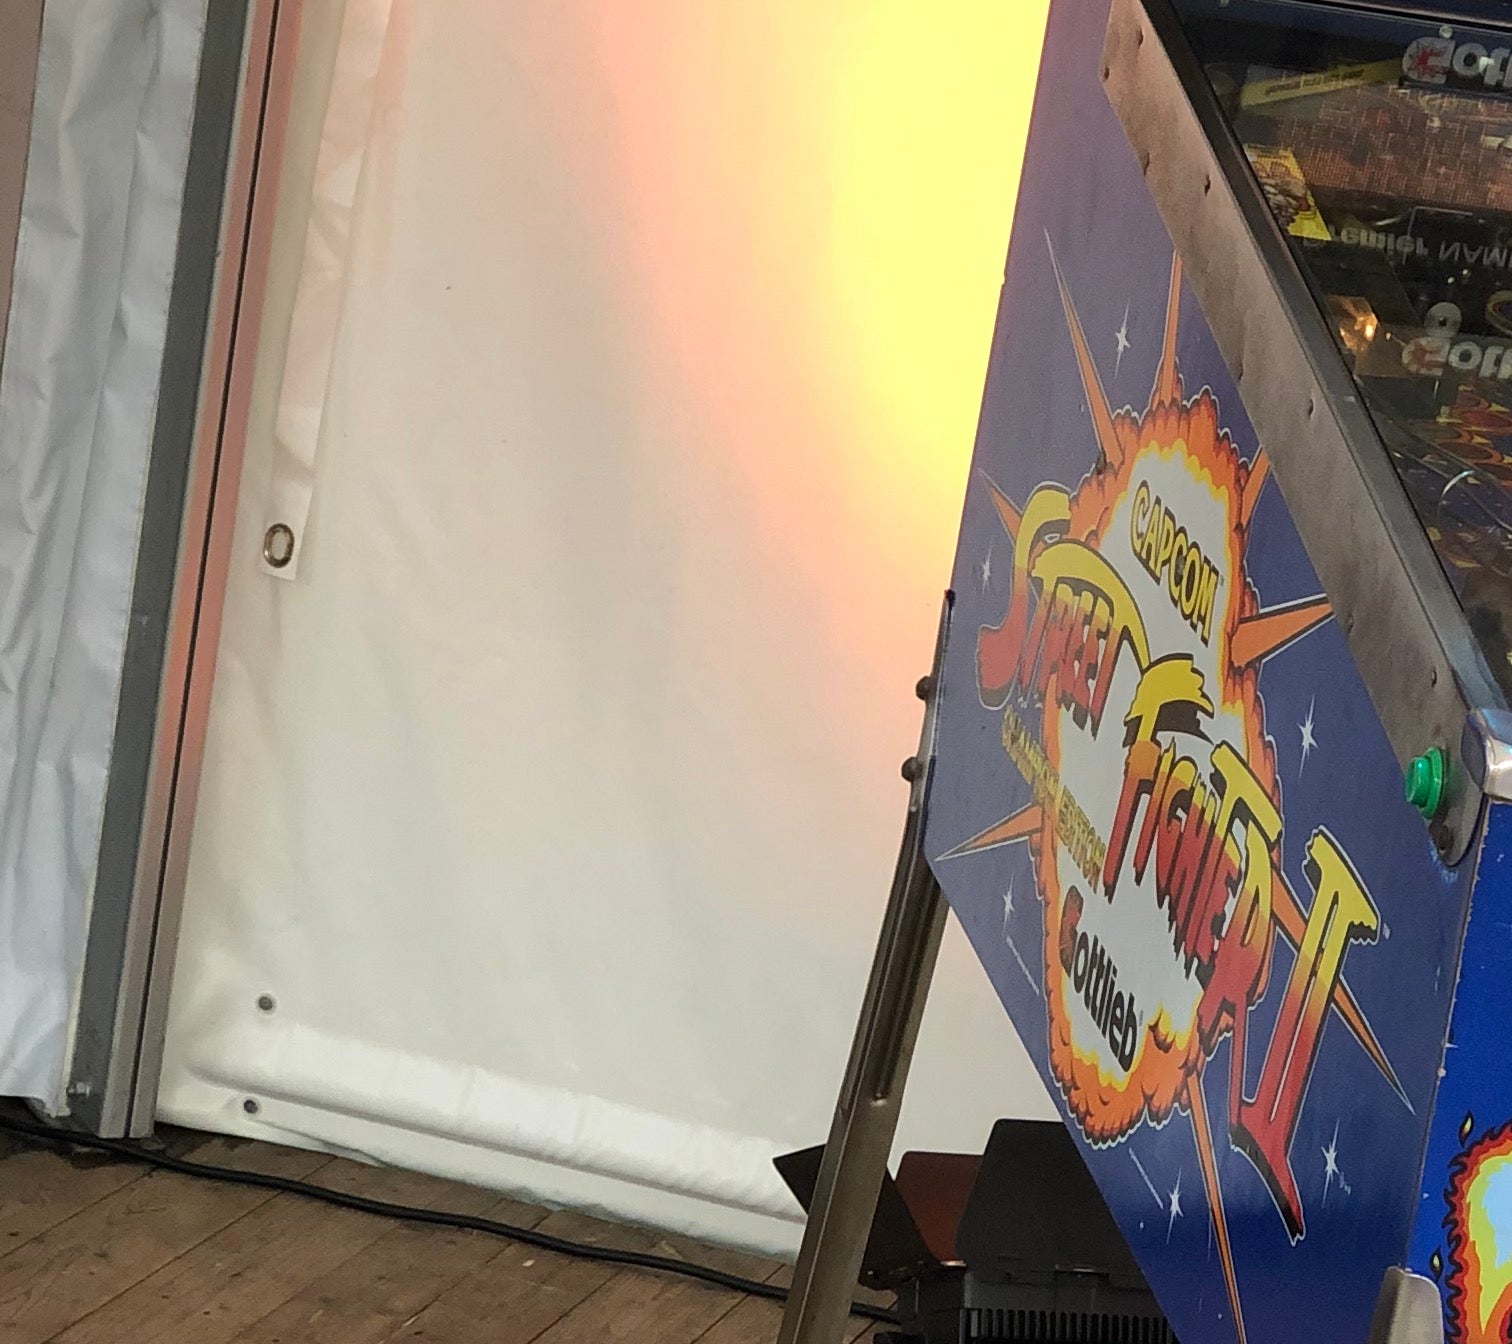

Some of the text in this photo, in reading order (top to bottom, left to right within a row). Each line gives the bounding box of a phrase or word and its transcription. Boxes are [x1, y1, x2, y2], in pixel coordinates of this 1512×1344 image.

[1130, 479, 1220, 648] CAPCOM
[977, 482, 1150, 742] STREET
[1102, 653, 1285, 1066] FIGHTER
[1060, 885, 1138, 1073] Gottlieb
